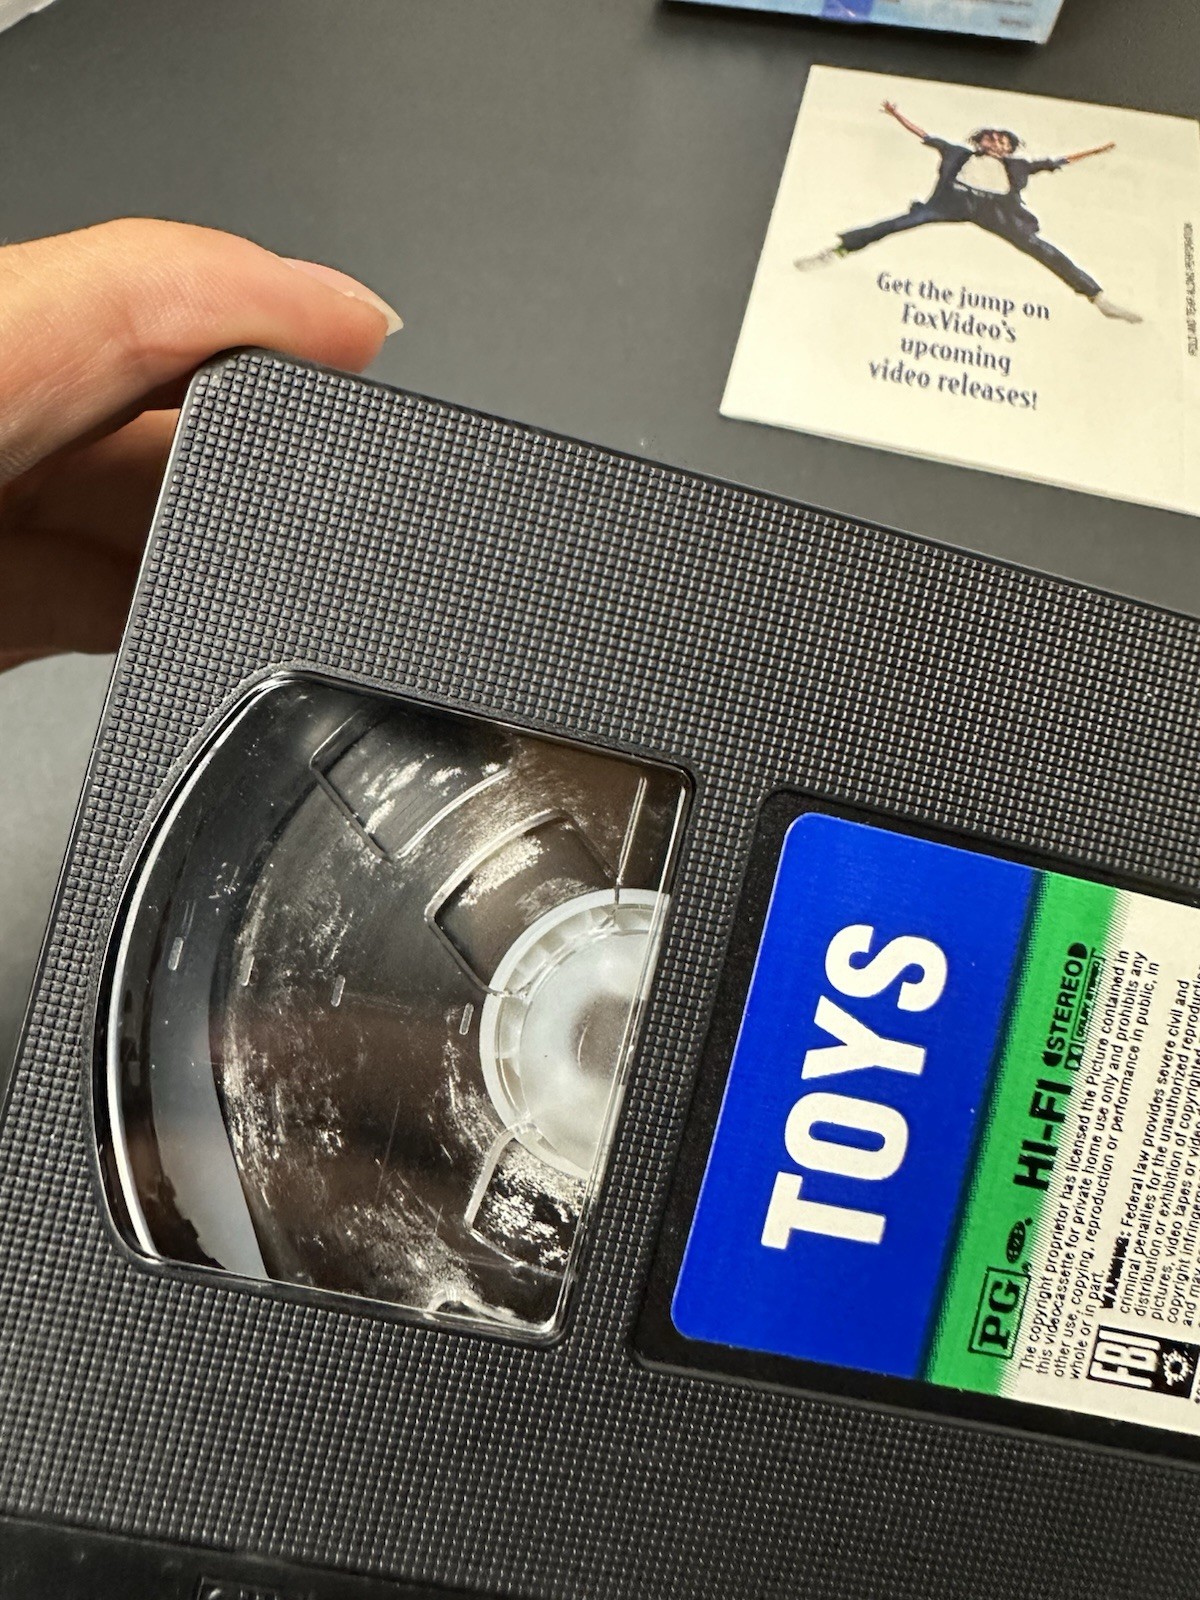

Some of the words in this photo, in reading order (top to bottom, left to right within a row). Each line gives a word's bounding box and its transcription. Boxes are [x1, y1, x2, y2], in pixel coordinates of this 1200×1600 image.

[877, 272, 913, 297] Get
[918, 280, 953, 304] the
[957, 286, 1015, 317] jump
[1022, 302, 1050, 320] on
[902, 302, 1017, 343] FoxVideo's
[900, 338, 1012, 377] upcoming
[868, 358, 931, 388] video
[937, 371, 1038, 411] releases!
[1114, 951, 1129, 963] in
[1131, 952, 1147, 976] any
[1145, 963, 1159, 975] in
[1047, 960, 1083, 1051] STEREO
[1101, 967, 1125, 1033] contained
[1117, 981, 1142, 1041] prohibits
[1137, 981, 1157, 1025] public,
[1129, 1029, 1144, 1041] in
[1085, 1038, 1108, 1085] Picture
[1109, 1045, 1123, 1070] and
[760, 924, 949, 1250] TOYS
[1080, 1090, 1096, 1111] the
[1102, 1073, 1119, 1103] only
[1111, 1046, 1139, 1132] performance
[1121, 1178, 1143, 1227] Federal
[1133, 1150, 1149, 1174] law
[1143, 1089, 1167, 1147] provides
[1157, 1041, 1176, 1084] severe
[1167, 1009, 1183, 1036] civil
[1175, 980, 1189, 1006] and
[1160, 1054, 1189, 1141] unauthorized
[1013, 1079, 1073, 1191] HI-FI
[1095, 1107, 1108, 1131] use
[1175, 1132, 1187, 1146] of
[1064, 1114, 1090, 1171] licensed
[1082, 1136, 1102, 1174] home
[1107, 1135, 1118, 1150] or
[1152, 1146, 1167, 1166] the
[1059, 1176, 1076, 1199] has
[1146, 1170, 1161, 1190] for
[1159, 1151, 1182, 1216] exhibition
[1185, 1161, 1196, 1176] or
[1073, 1178, 1093, 1224] private
[1085, 1155, 1114, 1242] reproduction
[1173, 1181, 1192, 1216] tapes
[1045, 1203, 1069, 1273] proprietor
[1065, 1228, 1080, 1247] for
[1134, 1195, 1161, 1256] penalties
[1155, 1220, 1166, 1235] or
[1165, 1221, 1182, 1256] video
[1071, 1248, 1094, 1305] copying,
[1120, 1259, 1141, 1314] criminal
[1134, 1240, 1162, 1316] distribution
[1150, 1263, 1177, 1320] pictures,
[1162, 1259, 1190, 1323] copyright
[979, 1280, 1020, 1349] PG
[1029, 1277, 1052, 1342] copyright
[1044, 1253, 1075, 1344] videocassette
[1082, 1305, 1096, 1317] in
[1183, 1301, 1196, 1327] and
[1064, 1310, 1080, 1337] use,
[1081, 1321, 1091, 1335] or
[1019, 1347, 1036, 1369] The
[1036, 1350, 1052, 1374] this
[1054, 1341, 1070, 1377] other
[1070, 1341, 1087, 1379] whole
[1090, 1330, 1160, 1387] FBI
